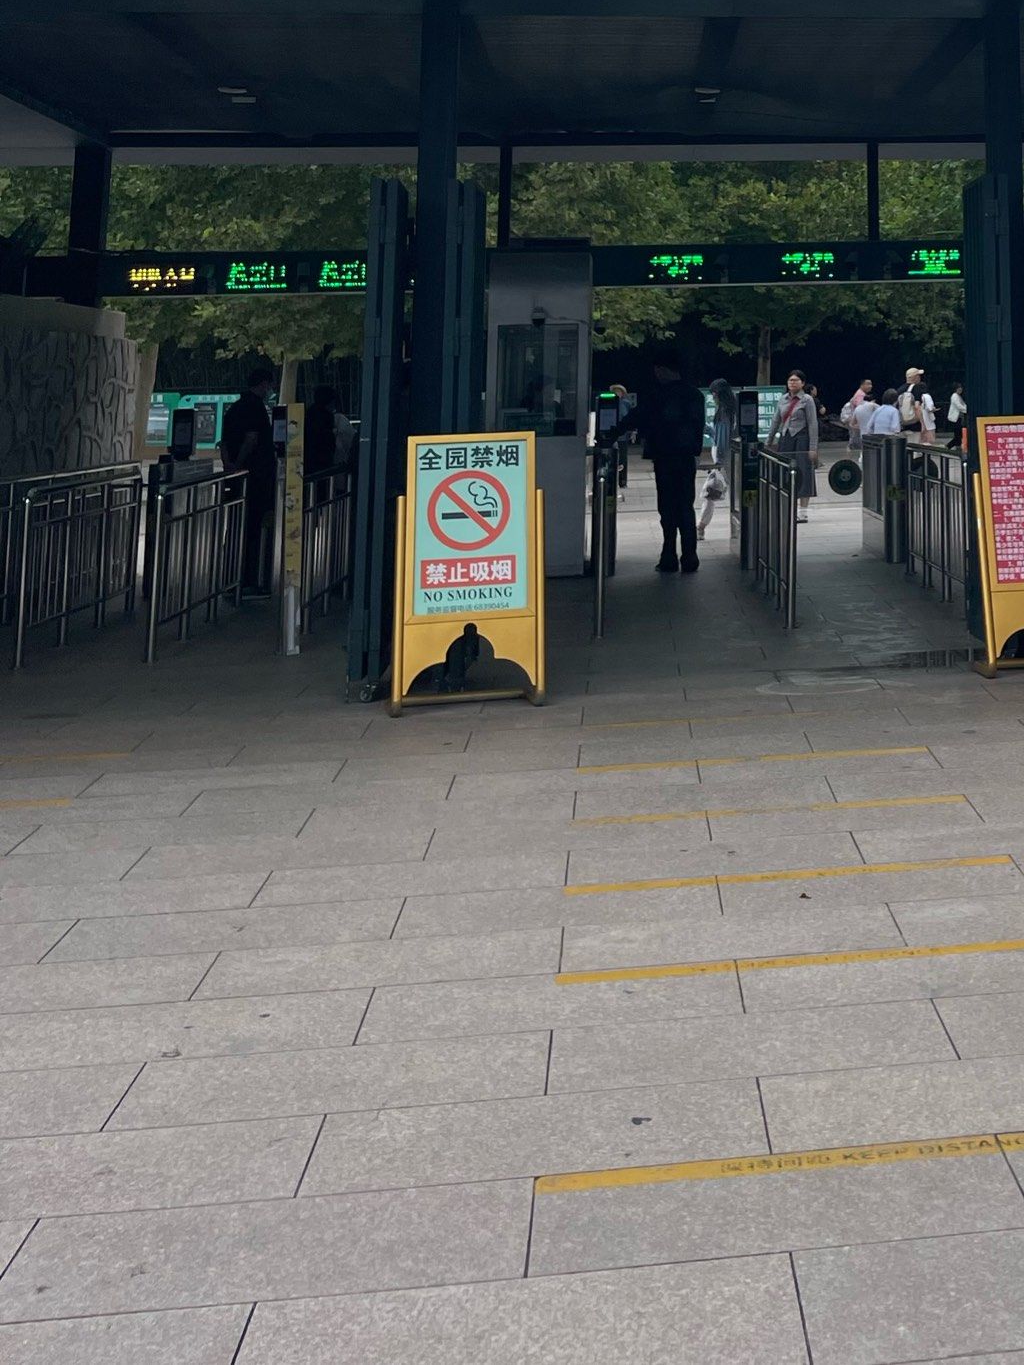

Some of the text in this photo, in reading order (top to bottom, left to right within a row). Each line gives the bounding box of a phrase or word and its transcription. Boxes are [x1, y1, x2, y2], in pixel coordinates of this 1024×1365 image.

[418, 444, 520, 471] 全园禁烟
[425, 559, 512, 586] 禁止吸烟
[424, 586, 513, 603] NO SMOKING
